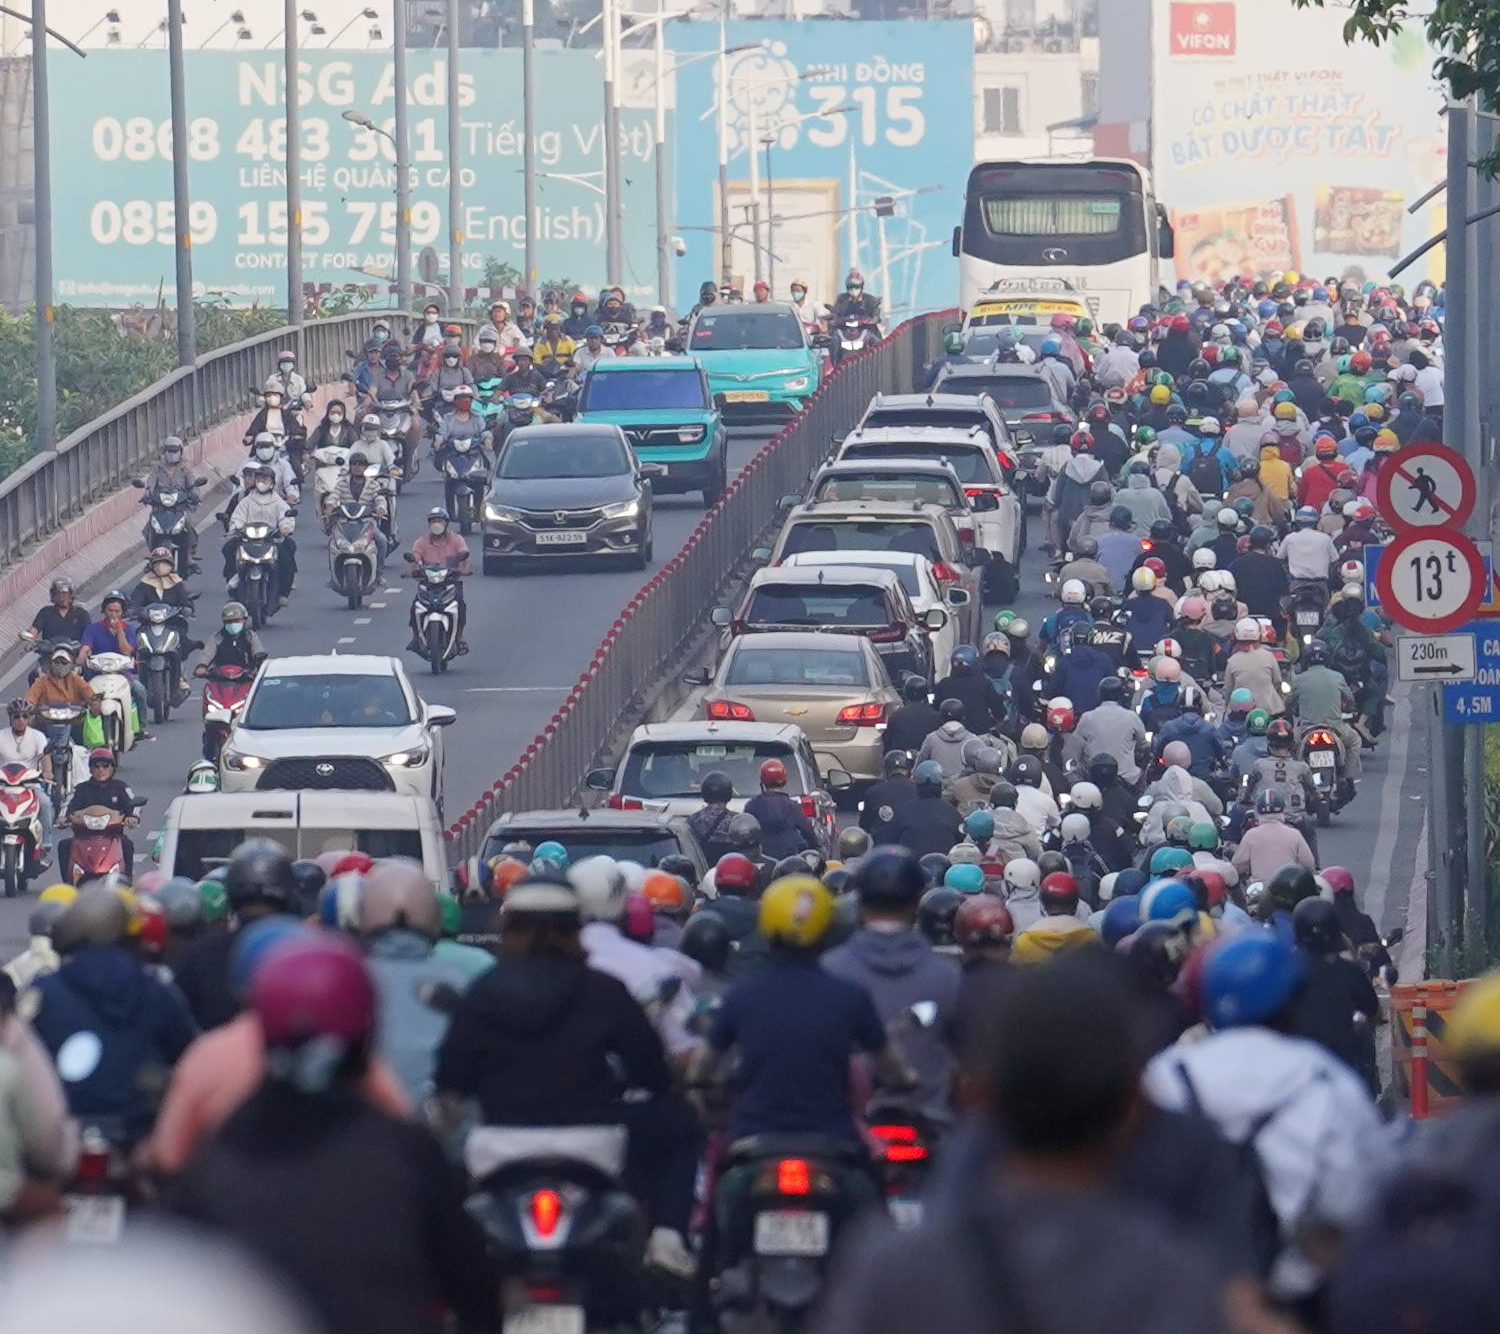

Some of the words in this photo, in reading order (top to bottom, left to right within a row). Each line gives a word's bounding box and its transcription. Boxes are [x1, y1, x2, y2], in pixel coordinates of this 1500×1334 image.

[1177, 32, 1230, 50] VIFON
[856, 55, 925, 83] ĐỒNG
[239, 62, 354, 107] NSG
[371, 60, 476, 107] Ads
[808, 86, 926, 147] 315
[236, 117, 330, 161] 483
[459, 119, 561, 164] Tiếng
[572, 120, 653, 163] Vệt)
[90, 200, 218, 245] 0859
[236, 201, 330, 245] 155
[346, 200, 441, 245] 759
[460, 201, 604, 249] English)
[322, 252, 353, 268] FOR
[362, 252, 483, 269] ADVRSNG
[1411, 644, 1448, 661] 230m
[1456, 696, 1493, 715] 4,5M
